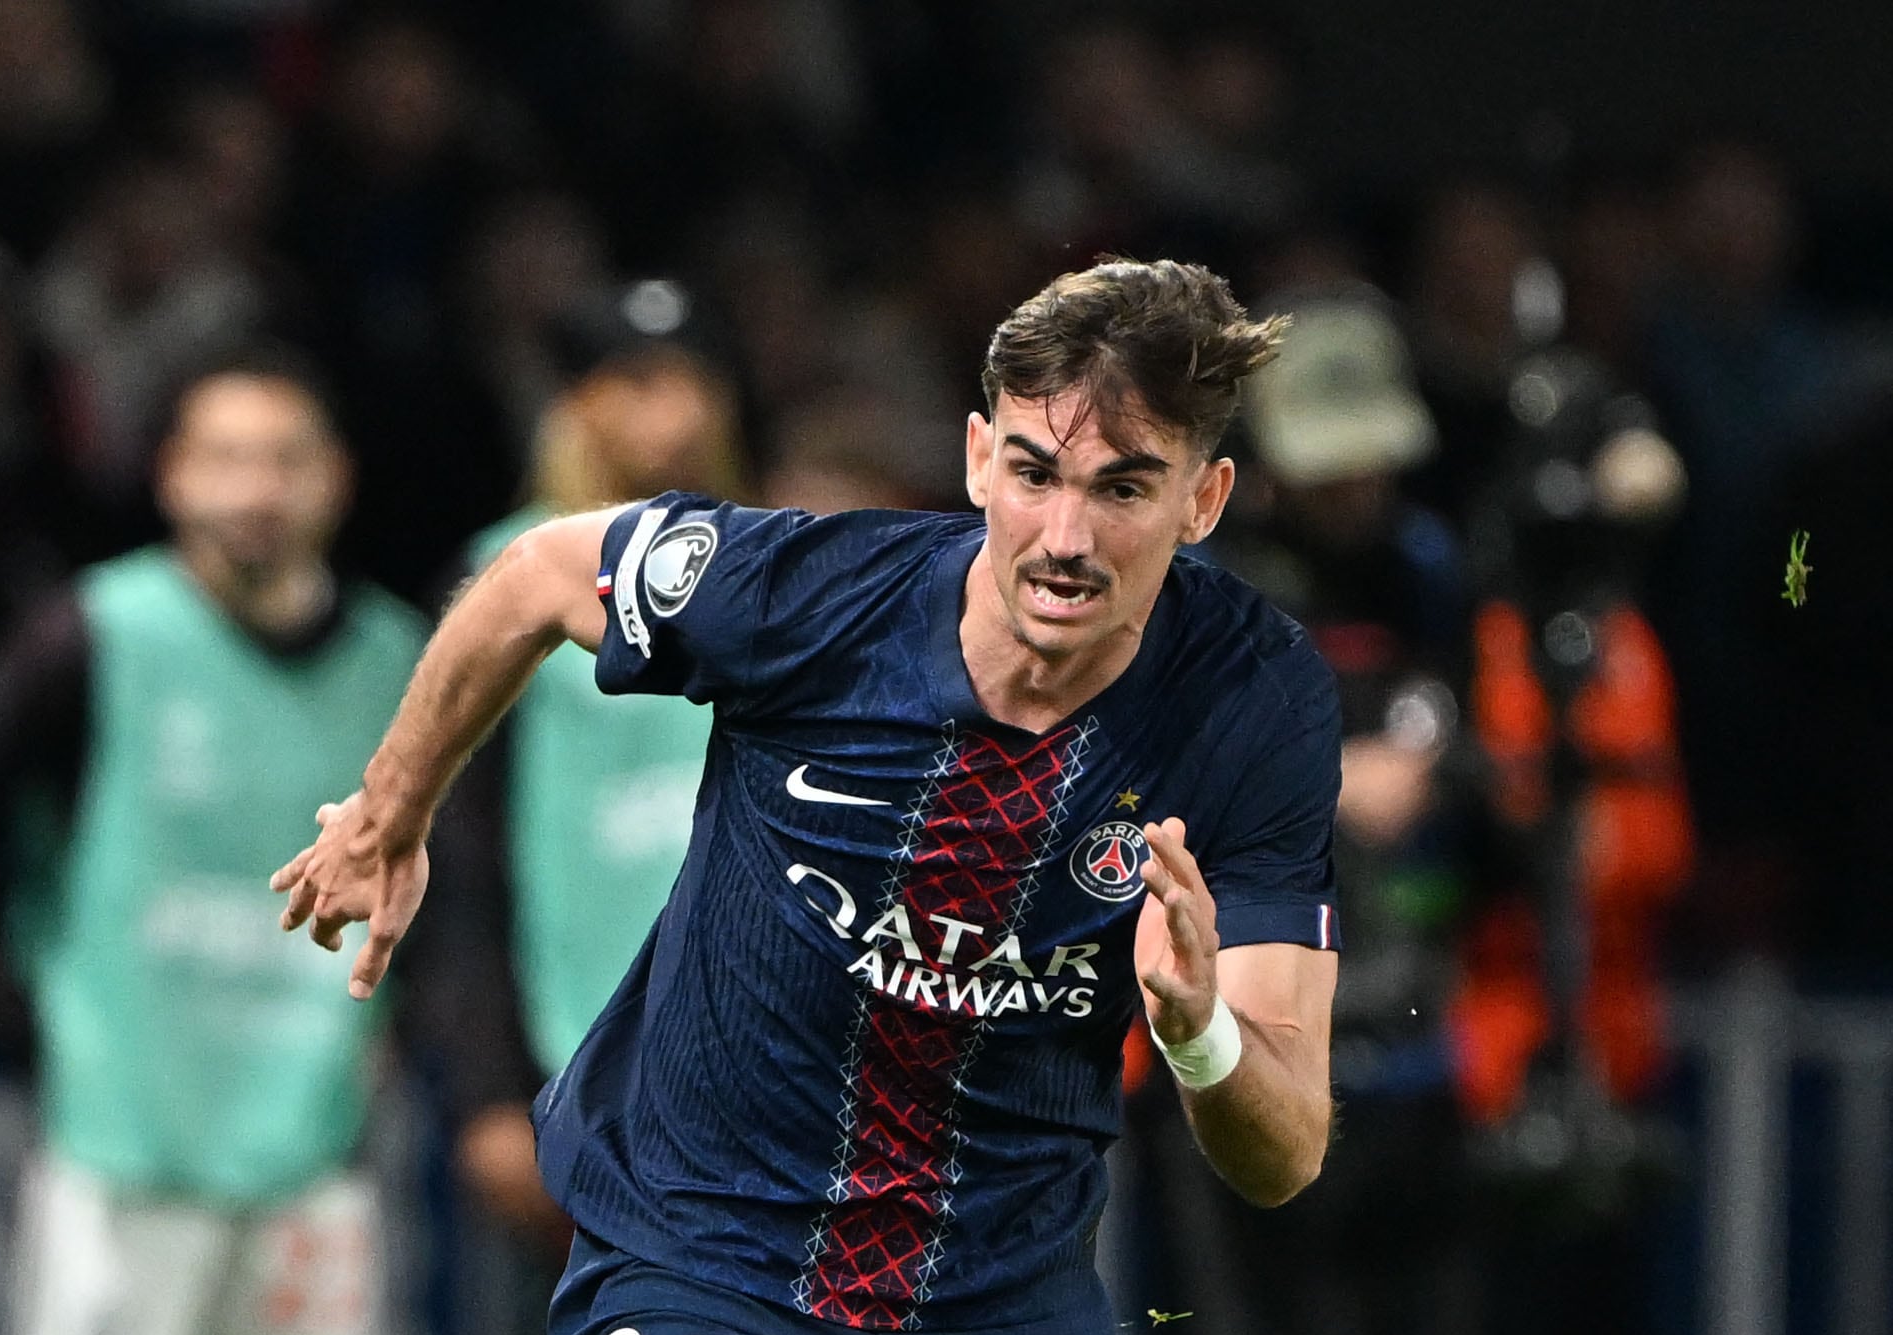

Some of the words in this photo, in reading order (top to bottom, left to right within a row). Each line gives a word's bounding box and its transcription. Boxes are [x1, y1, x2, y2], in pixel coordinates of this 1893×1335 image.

[1090, 825, 1145, 848] PARIS
[786, 863, 1101, 980] QATAR
[847, 948, 1095, 1018] AIRWAYS
